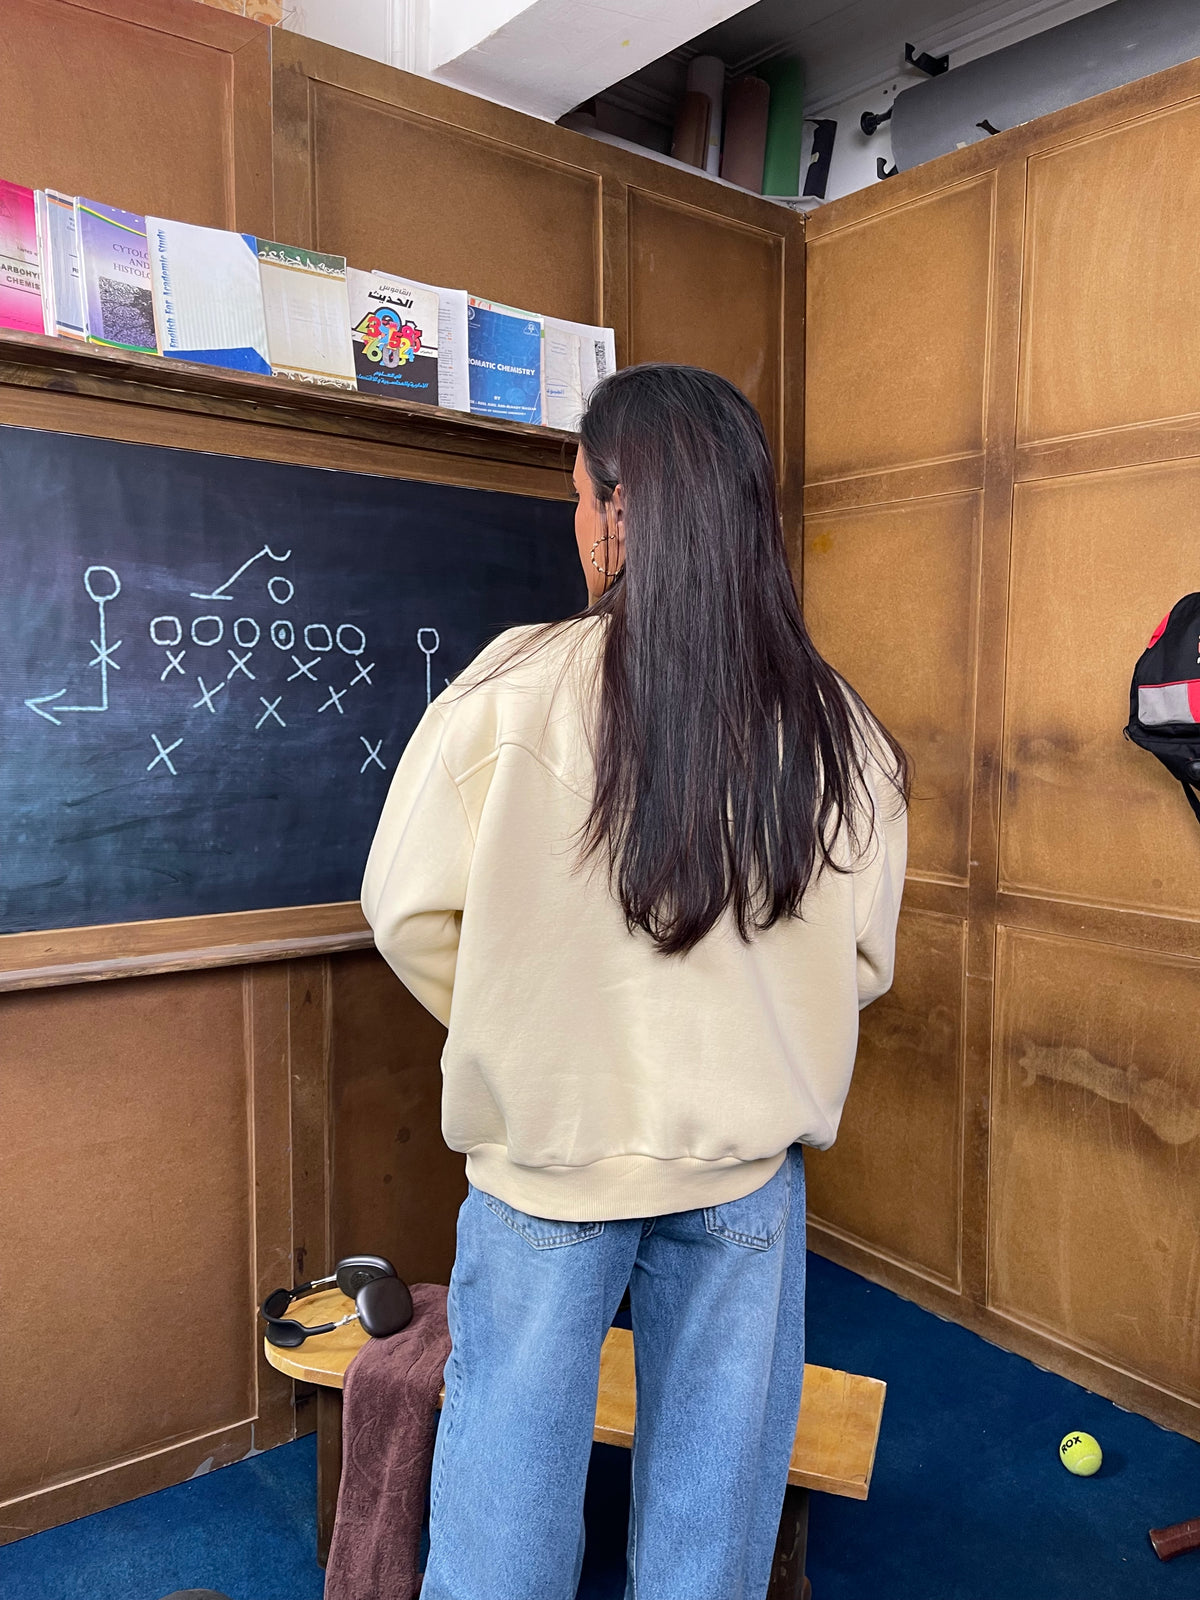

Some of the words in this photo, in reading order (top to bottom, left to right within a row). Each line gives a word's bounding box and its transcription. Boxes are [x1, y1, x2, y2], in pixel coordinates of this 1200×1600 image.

[156, 228, 168, 253] Study
[1, 263, 40, 280] ARBOHY
[129, 258, 150, 269] AND
[159, 254, 173, 297] Academic
[164, 300, 175, 315] For
[368, 291, 413, 308] الحديث
[497, 363, 536, 376] CHEMISTRY
[1061, 1436, 1082, 1454] ROX
